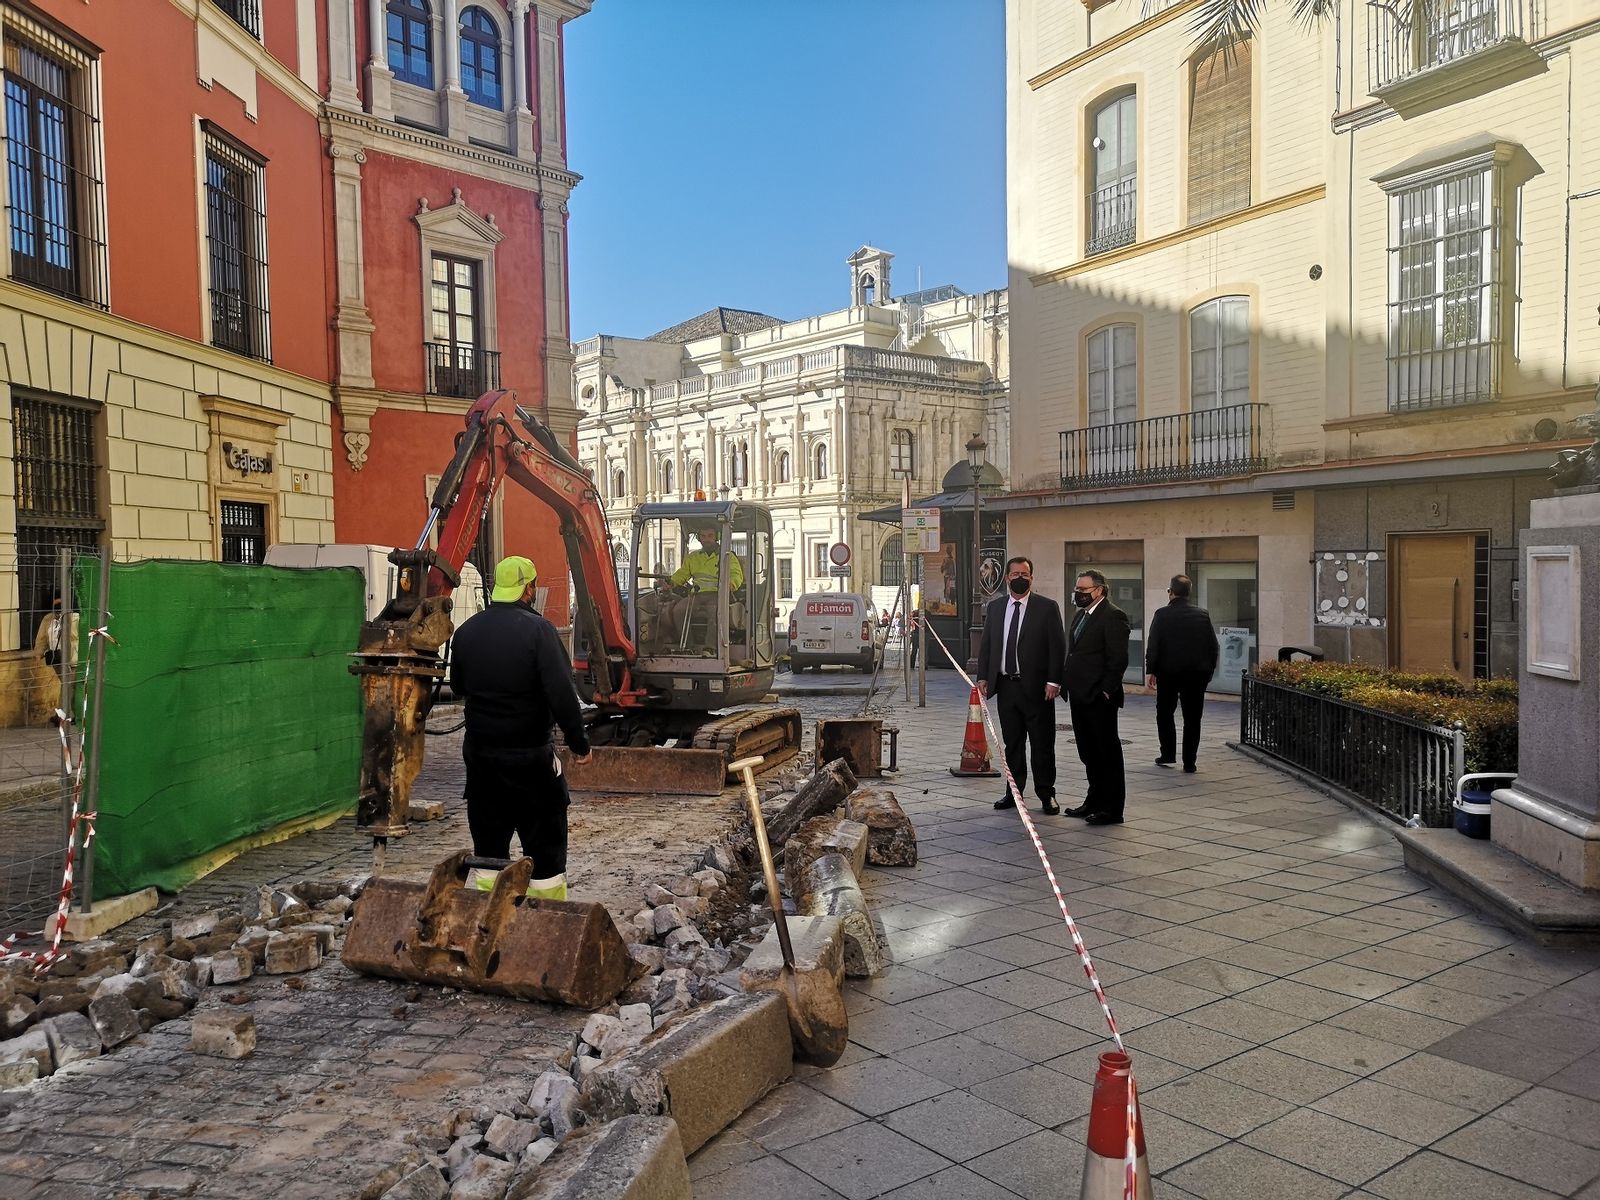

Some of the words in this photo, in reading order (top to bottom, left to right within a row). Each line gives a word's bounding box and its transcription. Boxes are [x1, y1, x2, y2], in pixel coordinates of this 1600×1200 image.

[1431, 502, 1440, 517] 2
[808, 603, 819, 613] el
[819, 602, 852, 614] jamón
